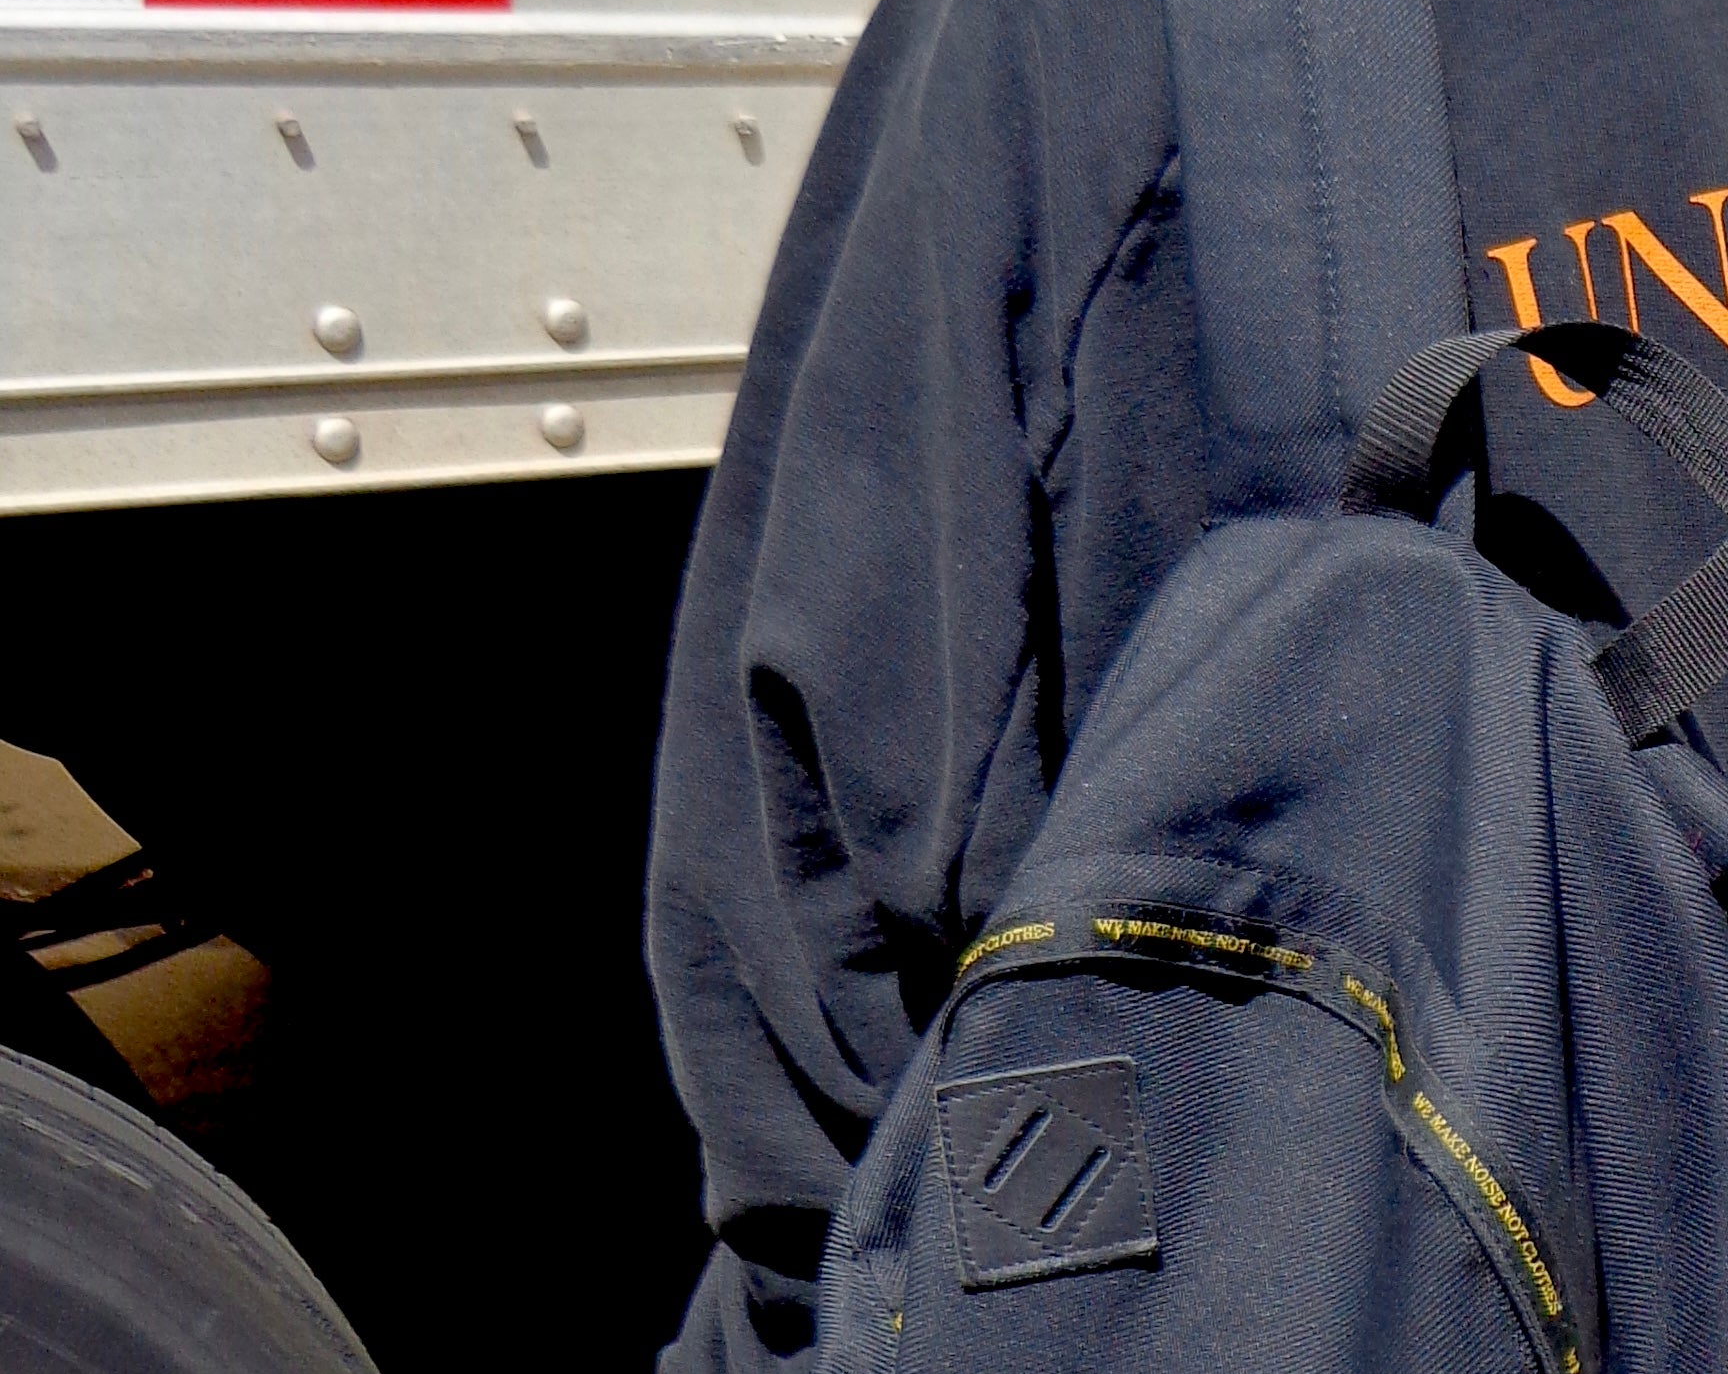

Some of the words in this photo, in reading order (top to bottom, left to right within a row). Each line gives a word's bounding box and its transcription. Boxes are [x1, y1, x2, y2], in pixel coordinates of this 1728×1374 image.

[985, 921, 1056, 953] CLOTHES
[1429, 1114, 1472, 1160] MAKE
[1464, 1154, 1507, 1209] NOISE
[1499, 1202, 1530, 1242] NOT
